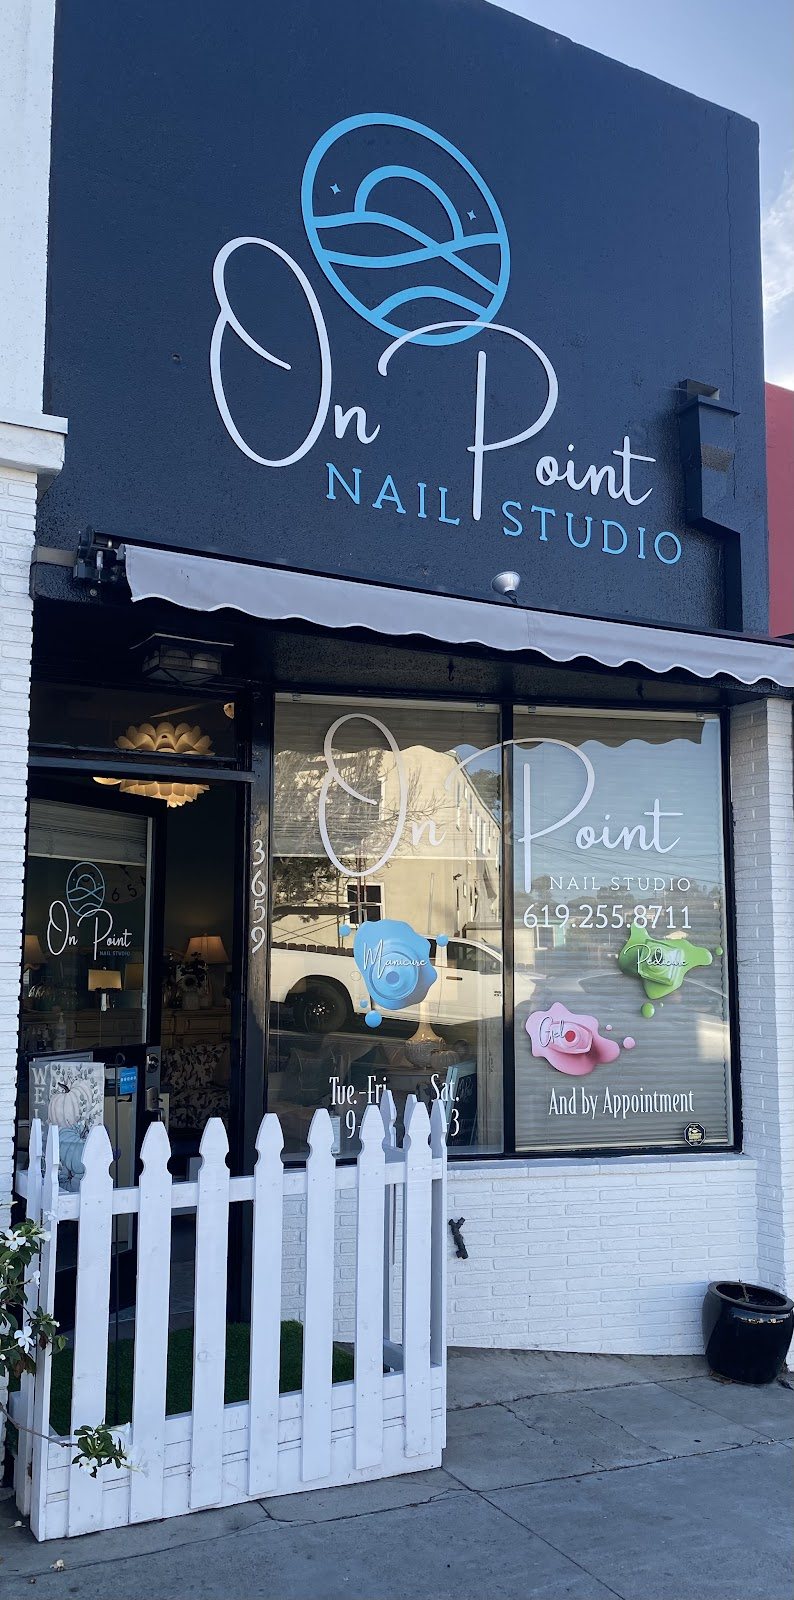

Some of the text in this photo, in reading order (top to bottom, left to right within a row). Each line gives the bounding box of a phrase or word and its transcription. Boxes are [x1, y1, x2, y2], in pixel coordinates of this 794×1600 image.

[210, 236, 657, 521] On Point
[325, 463, 682, 565] NAIL STUDIO
[319, 713, 684, 894] On Point
[251, 839, 266, 954] 3659
[550, 876, 691, 892] NAIL STUDIO
[47, 900, 133, 961] On Point
[523, 903, 692, 929] 619.255.8711
[363, 938, 427, 979] Manicure
[624, 943, 688, 975] Pedicure
[540, 1016, 566, 1048] Gel
[430, 1074, 460, 1102] Sat.
[548, 1086, 695, 1120] And by Appointment
